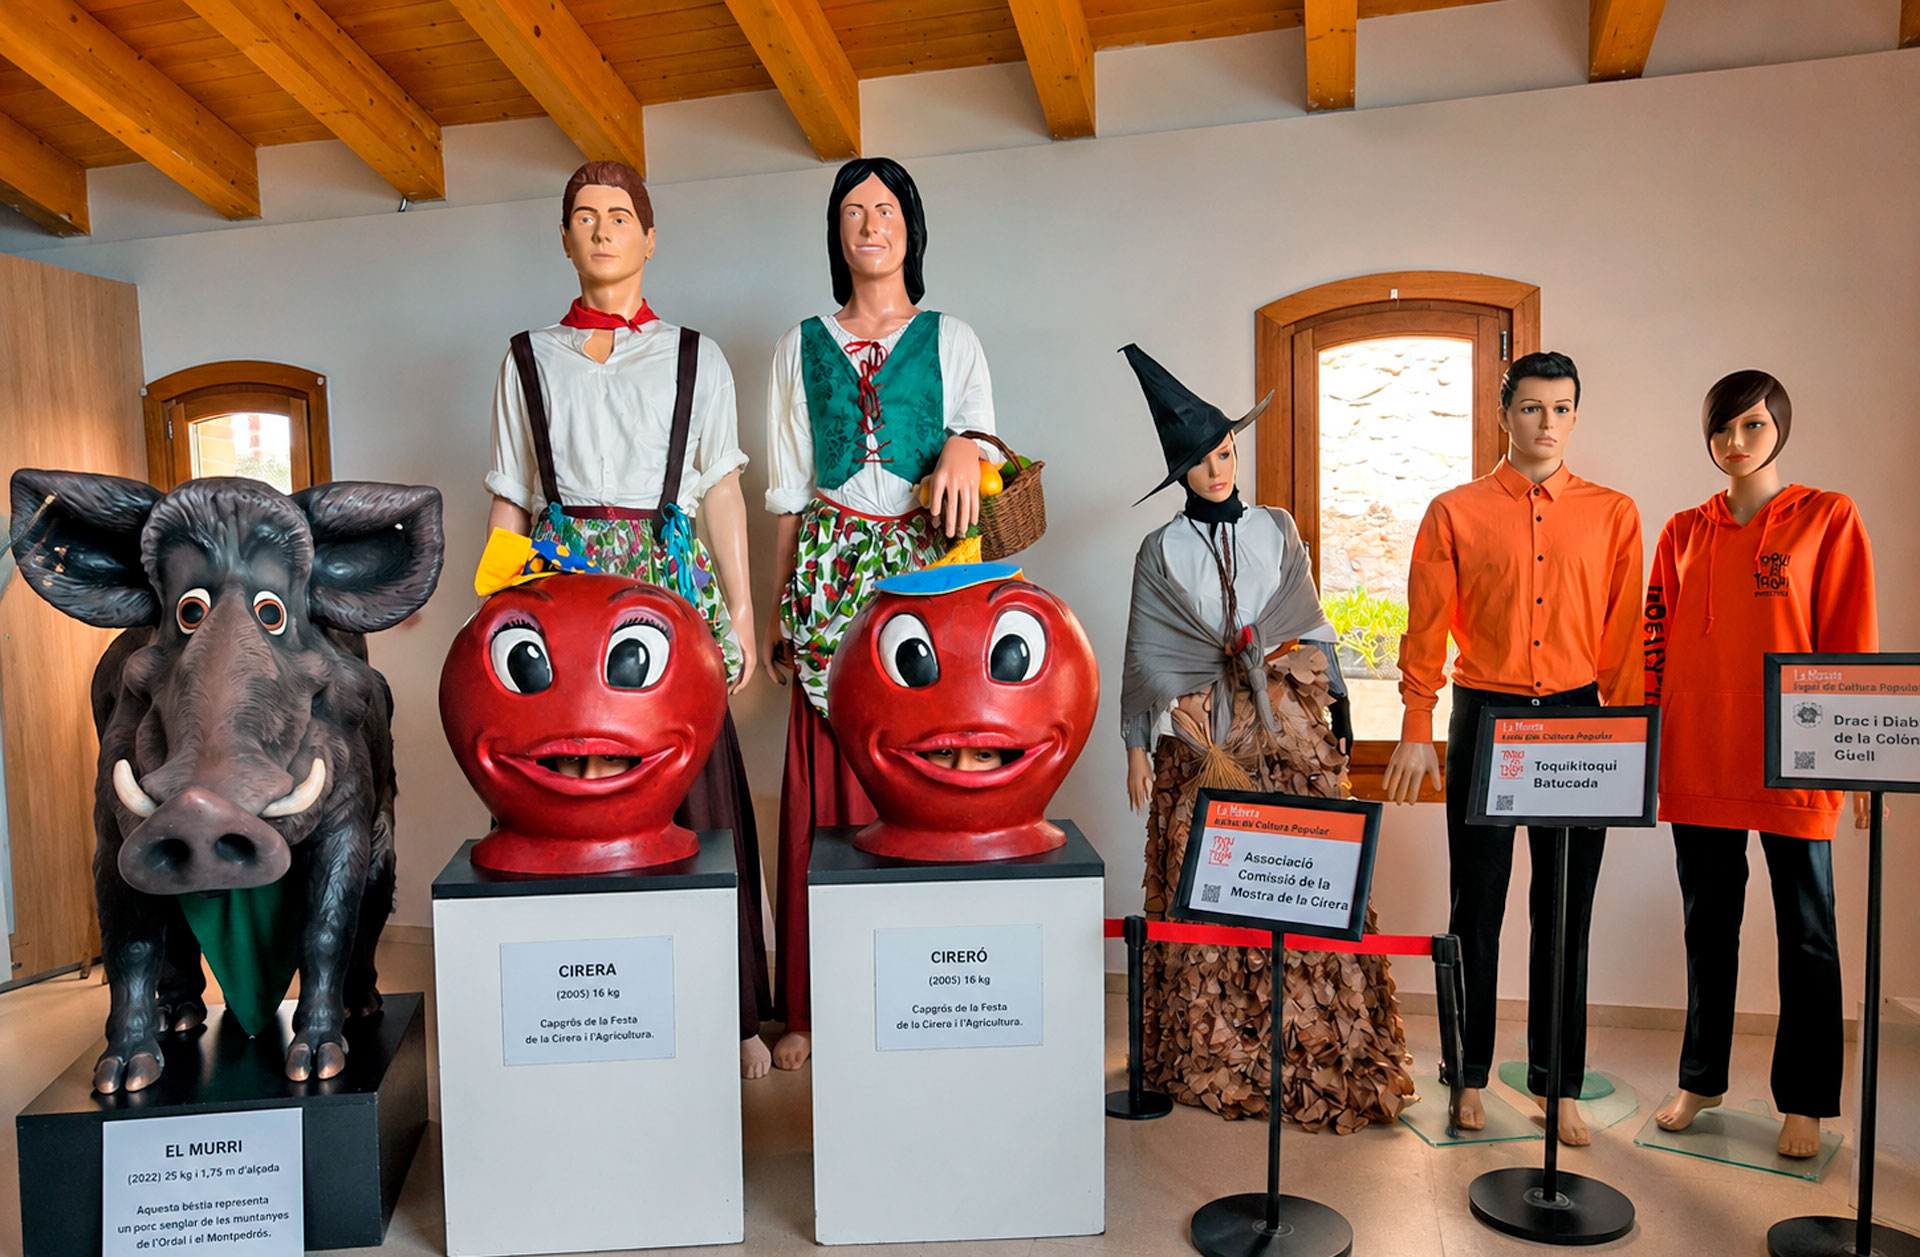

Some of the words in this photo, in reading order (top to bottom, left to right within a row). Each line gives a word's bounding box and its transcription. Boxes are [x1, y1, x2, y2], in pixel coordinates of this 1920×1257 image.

[1834, 714, 1869, 726] Drac
[1874, 716, 1878, 726] i
[1834, 733, 1852, 744] de
[1858, 734, 1870, 744] la
[1834, 750, 1874, 761] Güell
[1534, 760, 1618, 772] Toquikitoqui
[1534, 778, 1598, 788] Batucada
[1291, 824, 1330, 836] Popular
[1244, 852, 1314, 870] Associació
[1238, 869, 1296, 886] Comissió
[1299, 876, 1315, 888] de
[1318, 878, 1330, 890] la
[1230, 886, 1274, 902] Mostra
[1278, 892, 1293, 904] de
[1296, 894, 1308, 905] la
[1310, 896, 1348, 910] Cirera
[931, 947, 988, 963] CIRERÓ
[558, 963, 616, 977] CIRERA
[928, 976, 960, 986] (2005)
[964, 976, 976, 984] 16
[978, 975, 990, 985] kg
[556, 990, 590, 1000] (2005)
[593, 989, 604, 998] 16
[608, 988, 620, 998] kg
[954, 1004, 967, 1012] de
[970, 1004, 978, 1012] la
[981, 1003, 1008, 1011] Festa
[584, 1018, 596, 1026] de
[599, 1017, 608, 1025] la
[610, 1016, 638, 1024] Festa
[896, 1021, 908, 1029] de
[912, 1020, 920, 1029] la
[922, 1020, 952, 1028] Cirera
[526, 1036, 538, 1044] de
[540, 1035, 549, 1043] la
[552, 1034, 582, 1043] Cirera
[166, 1144, 184, 1158] EL
[190, 1140, 242, 1156] MURRI
[128, 1173, 161, 1186] (2022)
[165, 1171, 177, 1180] 25
[180, 1170, 192, 1182] kg
[195, 1169, 198, 1178] i
[202, 1168, 222, 1179] 1,75
[226, 1168, 236, 1176] m
[137, 1204, 180, 1216] Aquesta
[215, 1196, 269, 1208] representa
[118, 1225, 131, 1234] un
[134, 1223, 156, 1234] porc
[160, 1219, 197, 1232] senglar
[200, 1217, 214, 1226] de
[216, 1215, 230, 1224] les
[233, 1212, 289, 1223] muntanyes
[136, 1240, 150, 1249] de
[189, 1234, 192, 1244] i
[195, 1234, 204, 1244] el
